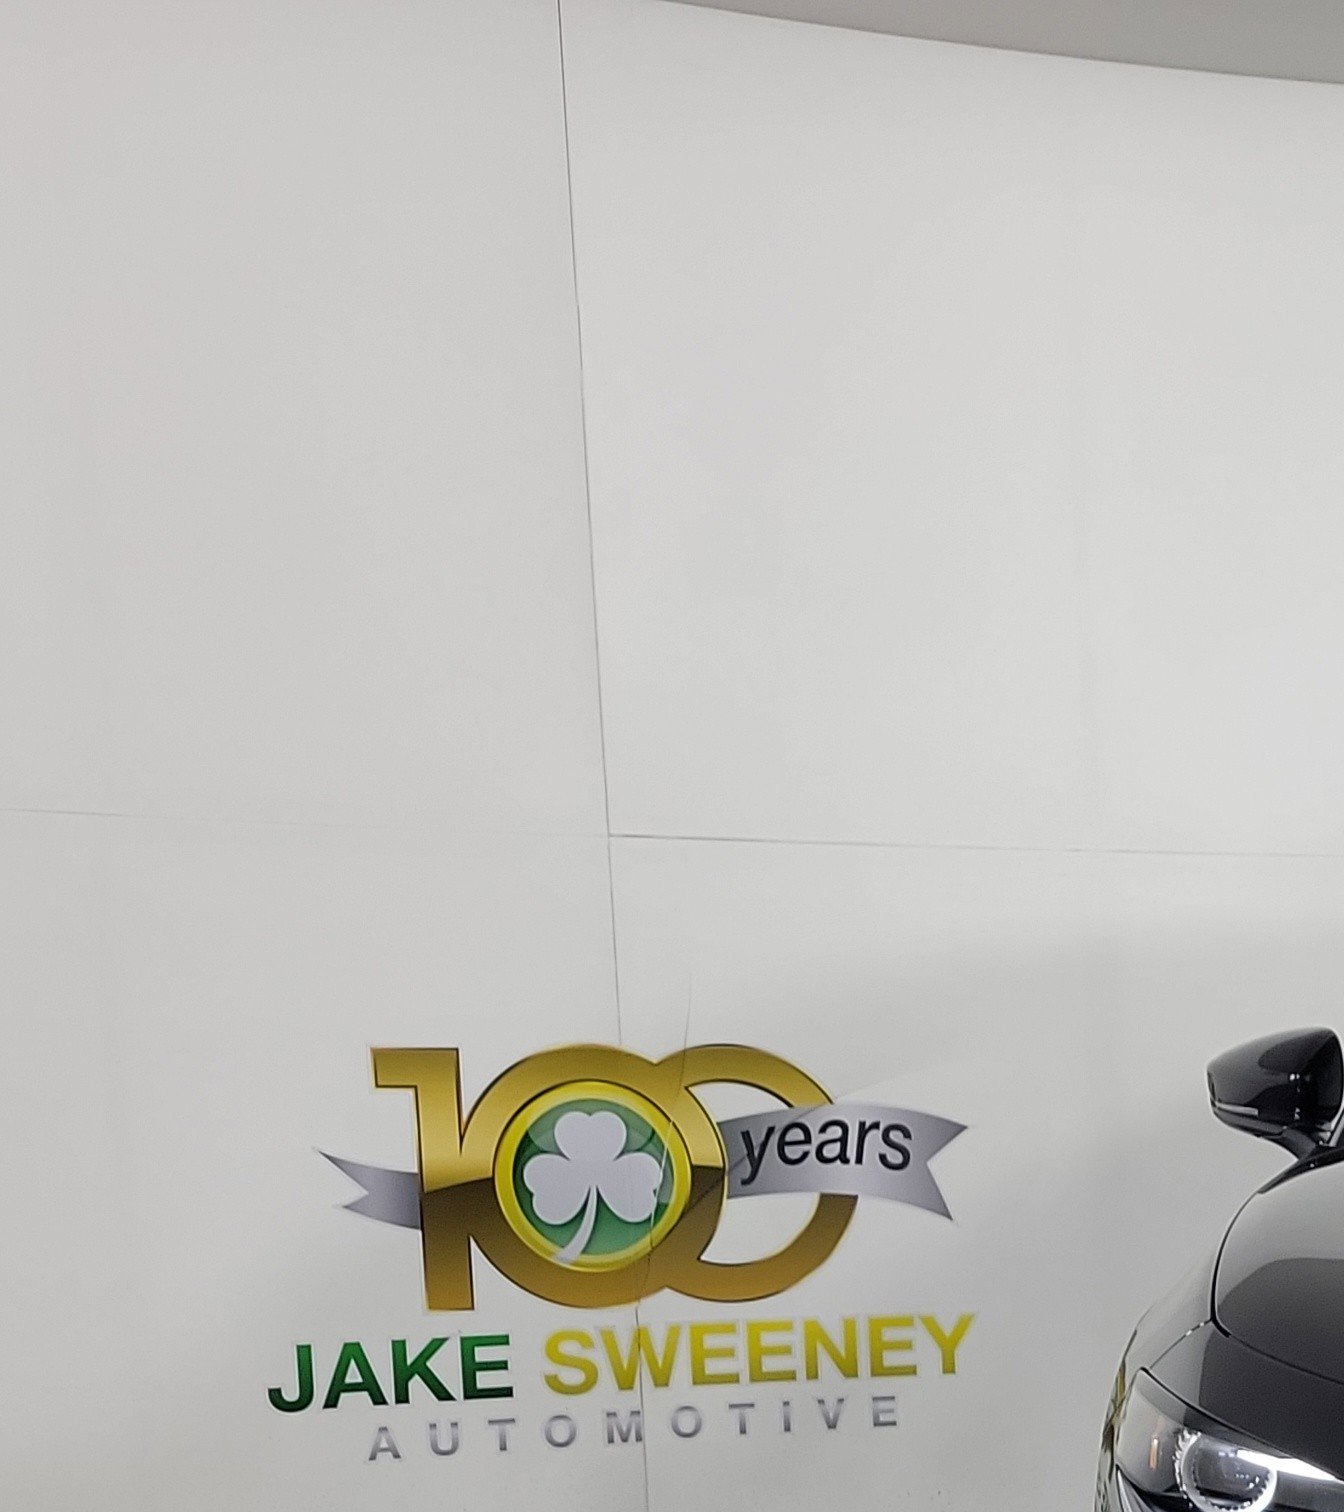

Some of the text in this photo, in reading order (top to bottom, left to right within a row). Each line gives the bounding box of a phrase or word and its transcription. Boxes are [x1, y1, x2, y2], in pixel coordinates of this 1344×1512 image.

[370, 1043, 914, 1312] 100 years
[268, 1312, 976, 1413] JAKE SWEENEY
[368, 1396, 899, 1462] AUTOMOTIVE
